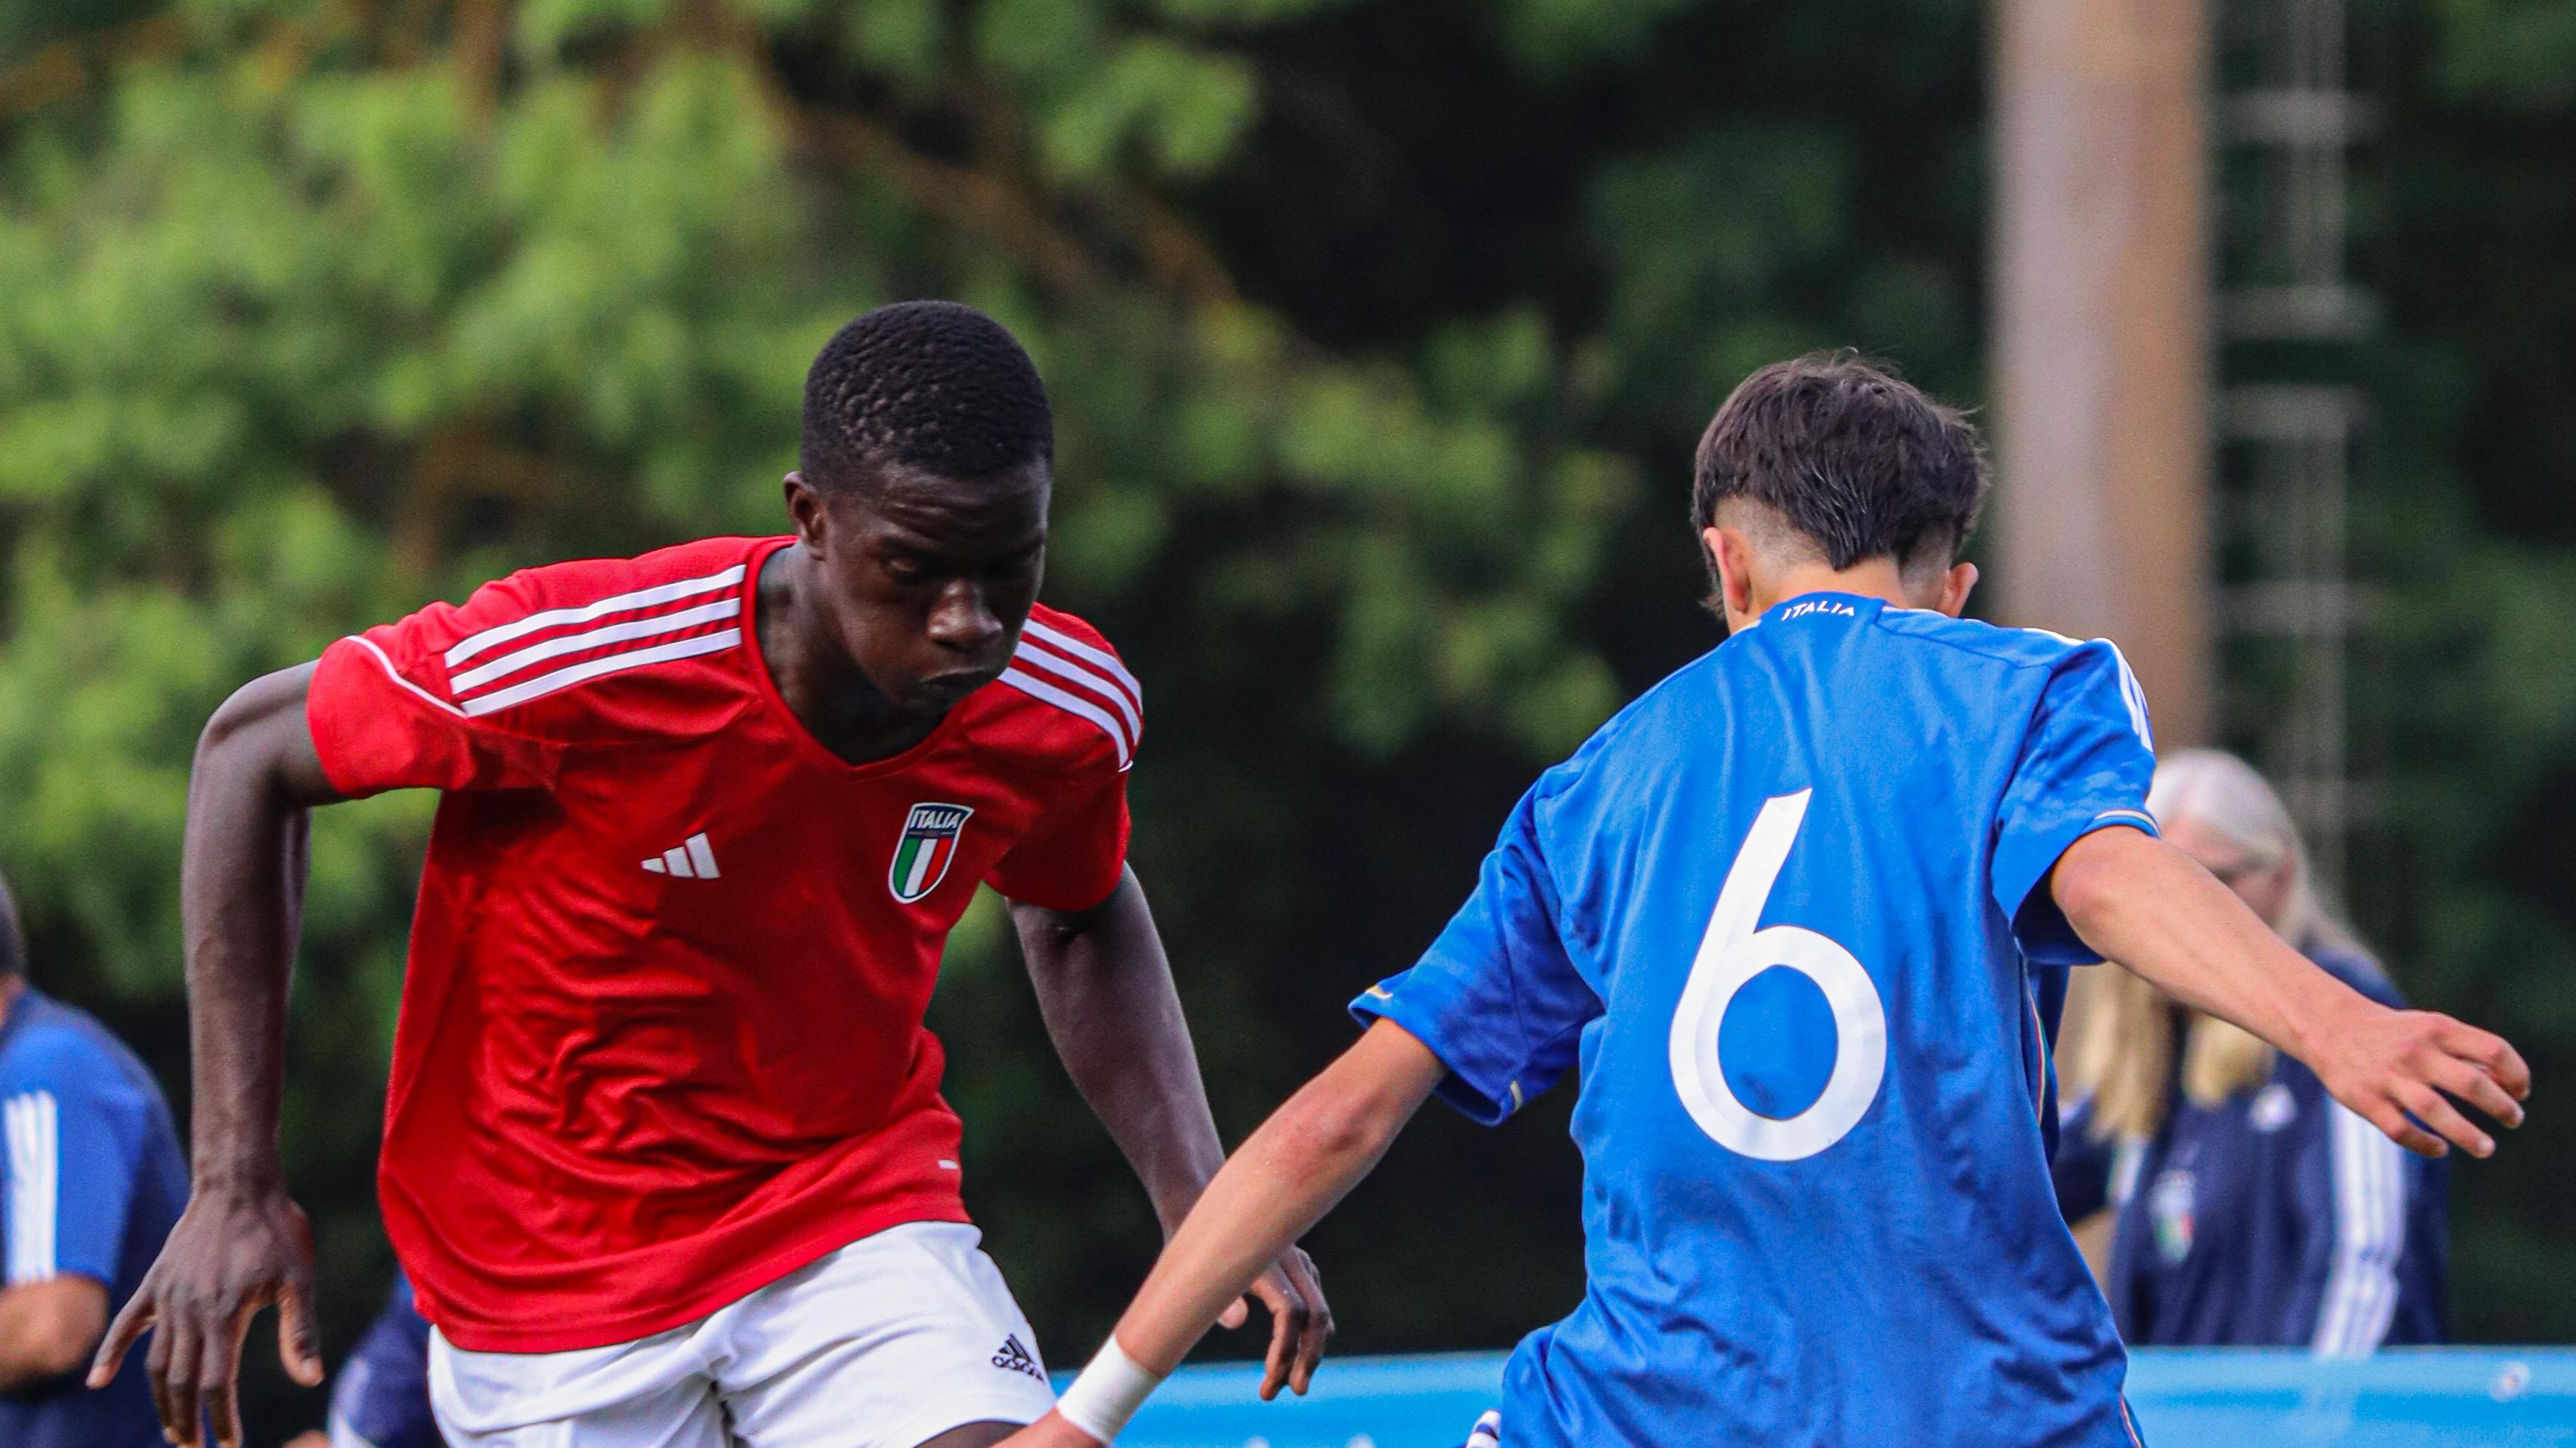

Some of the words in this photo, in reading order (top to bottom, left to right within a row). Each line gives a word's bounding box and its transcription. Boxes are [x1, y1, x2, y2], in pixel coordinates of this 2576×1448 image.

[1781, 600, 1854, 621] ITALIA
[910, 809, 961, 829] ITALIA
[1669, 788, 1887, 1161] 6
